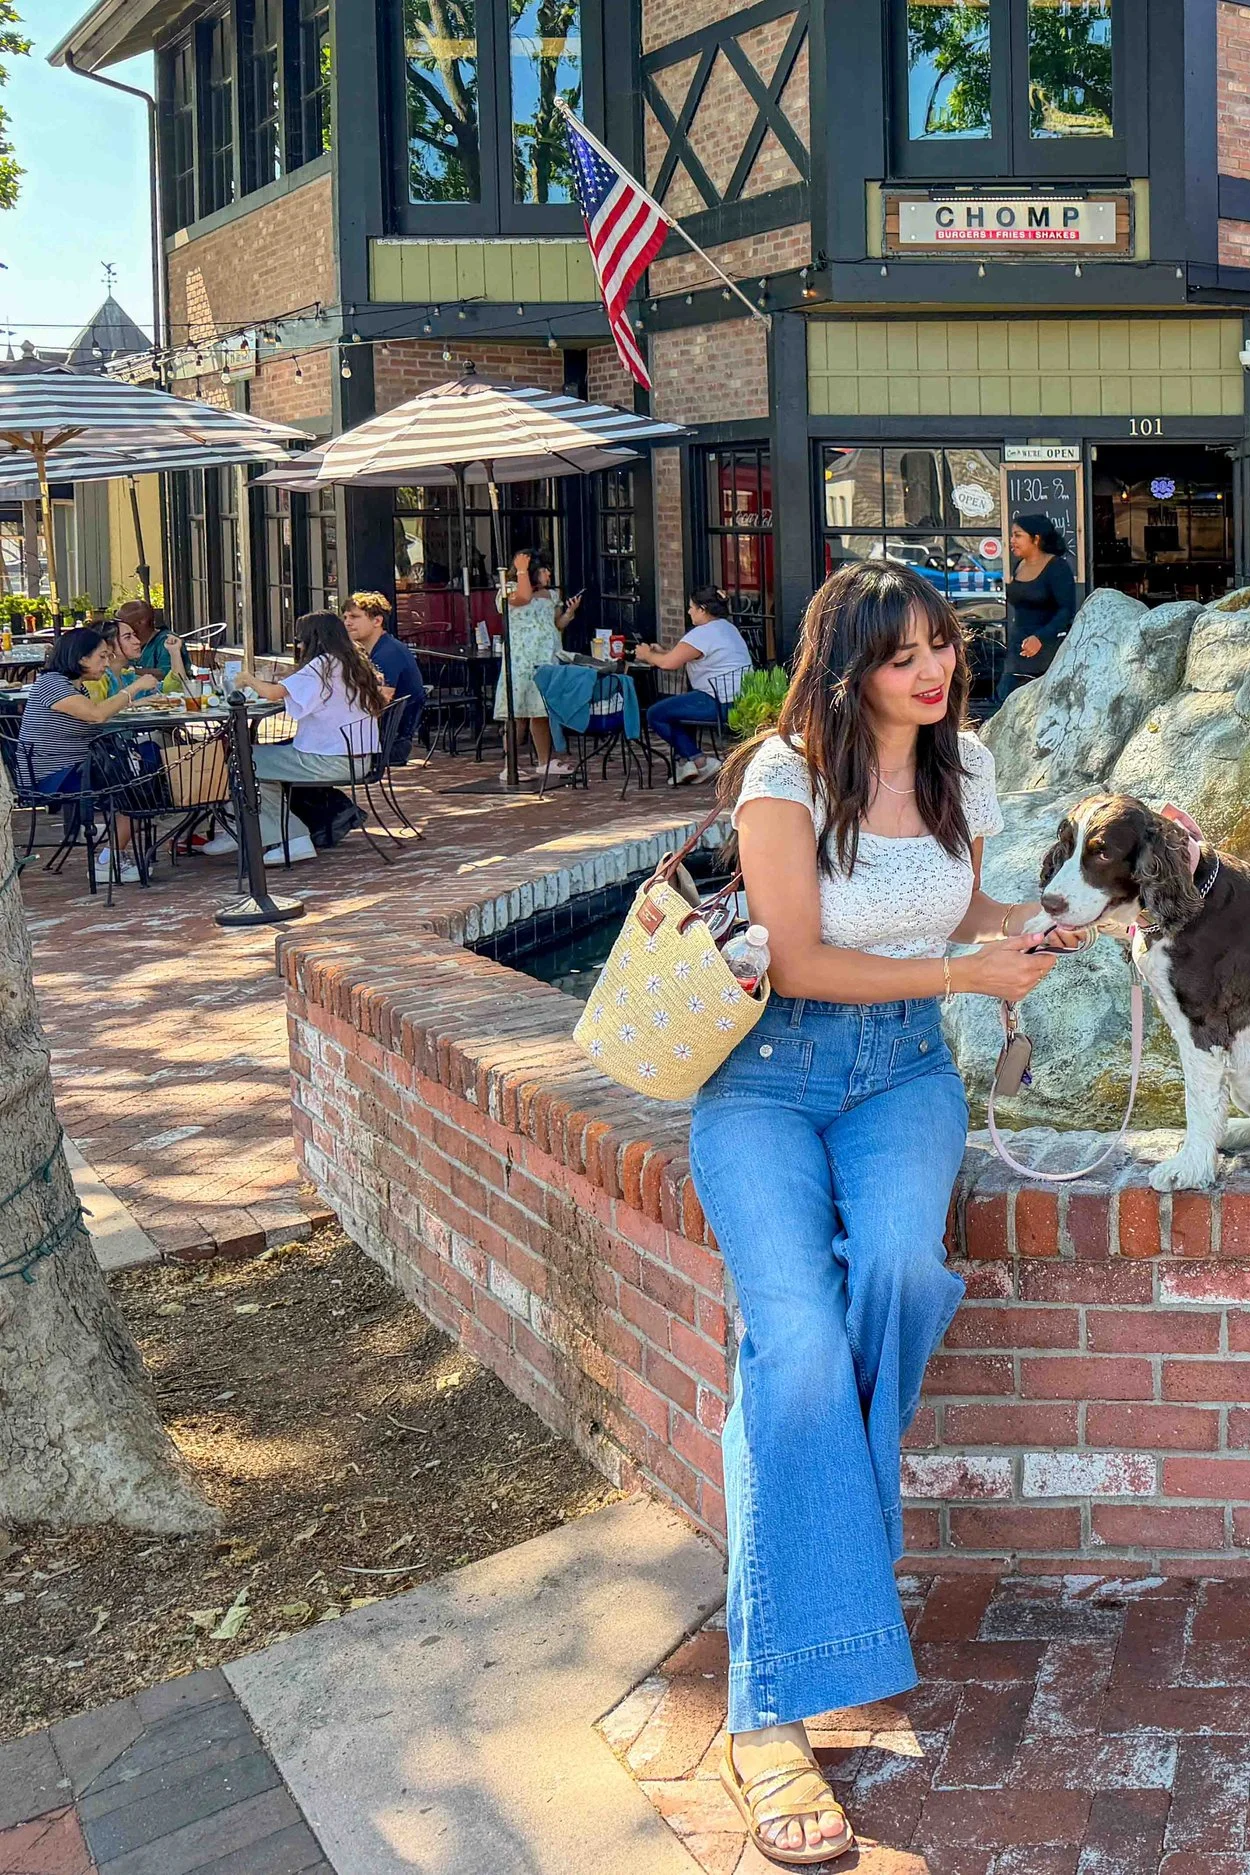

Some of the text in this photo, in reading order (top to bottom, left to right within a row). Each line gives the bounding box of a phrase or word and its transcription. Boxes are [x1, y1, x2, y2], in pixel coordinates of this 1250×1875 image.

[935, 206, 1080, 228] CHOMP
[938, 230, 987, 239] BURGERS
[996, 230, 1025, 239] FRIES
[1035, 230, 1076, 239] SHAKES
[1129, 418, 1164, 436] 101
[1046, 448, 1075, 458] OPEN
[958, 493, 987, 510] OPEN
